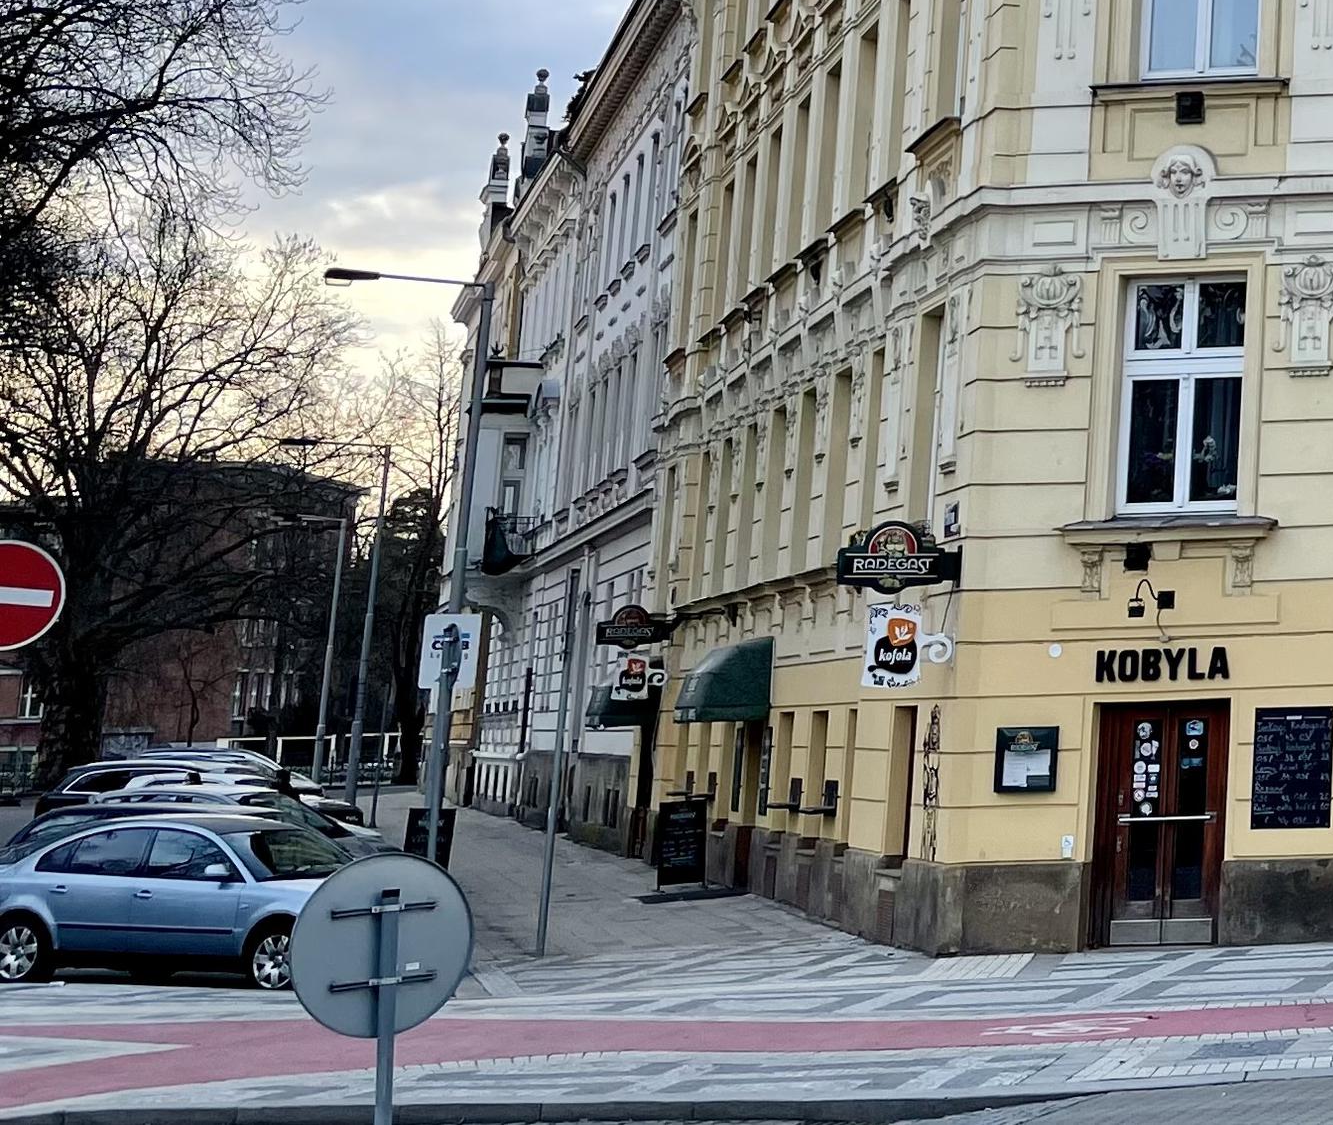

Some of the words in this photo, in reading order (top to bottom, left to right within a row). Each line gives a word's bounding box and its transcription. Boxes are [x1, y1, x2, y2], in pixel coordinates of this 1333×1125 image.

[853, 557, 934, 574] RADEGAST
[878, 647, 913, 665] kofola
[1095, 646, 1230, 683] KOBYLA
